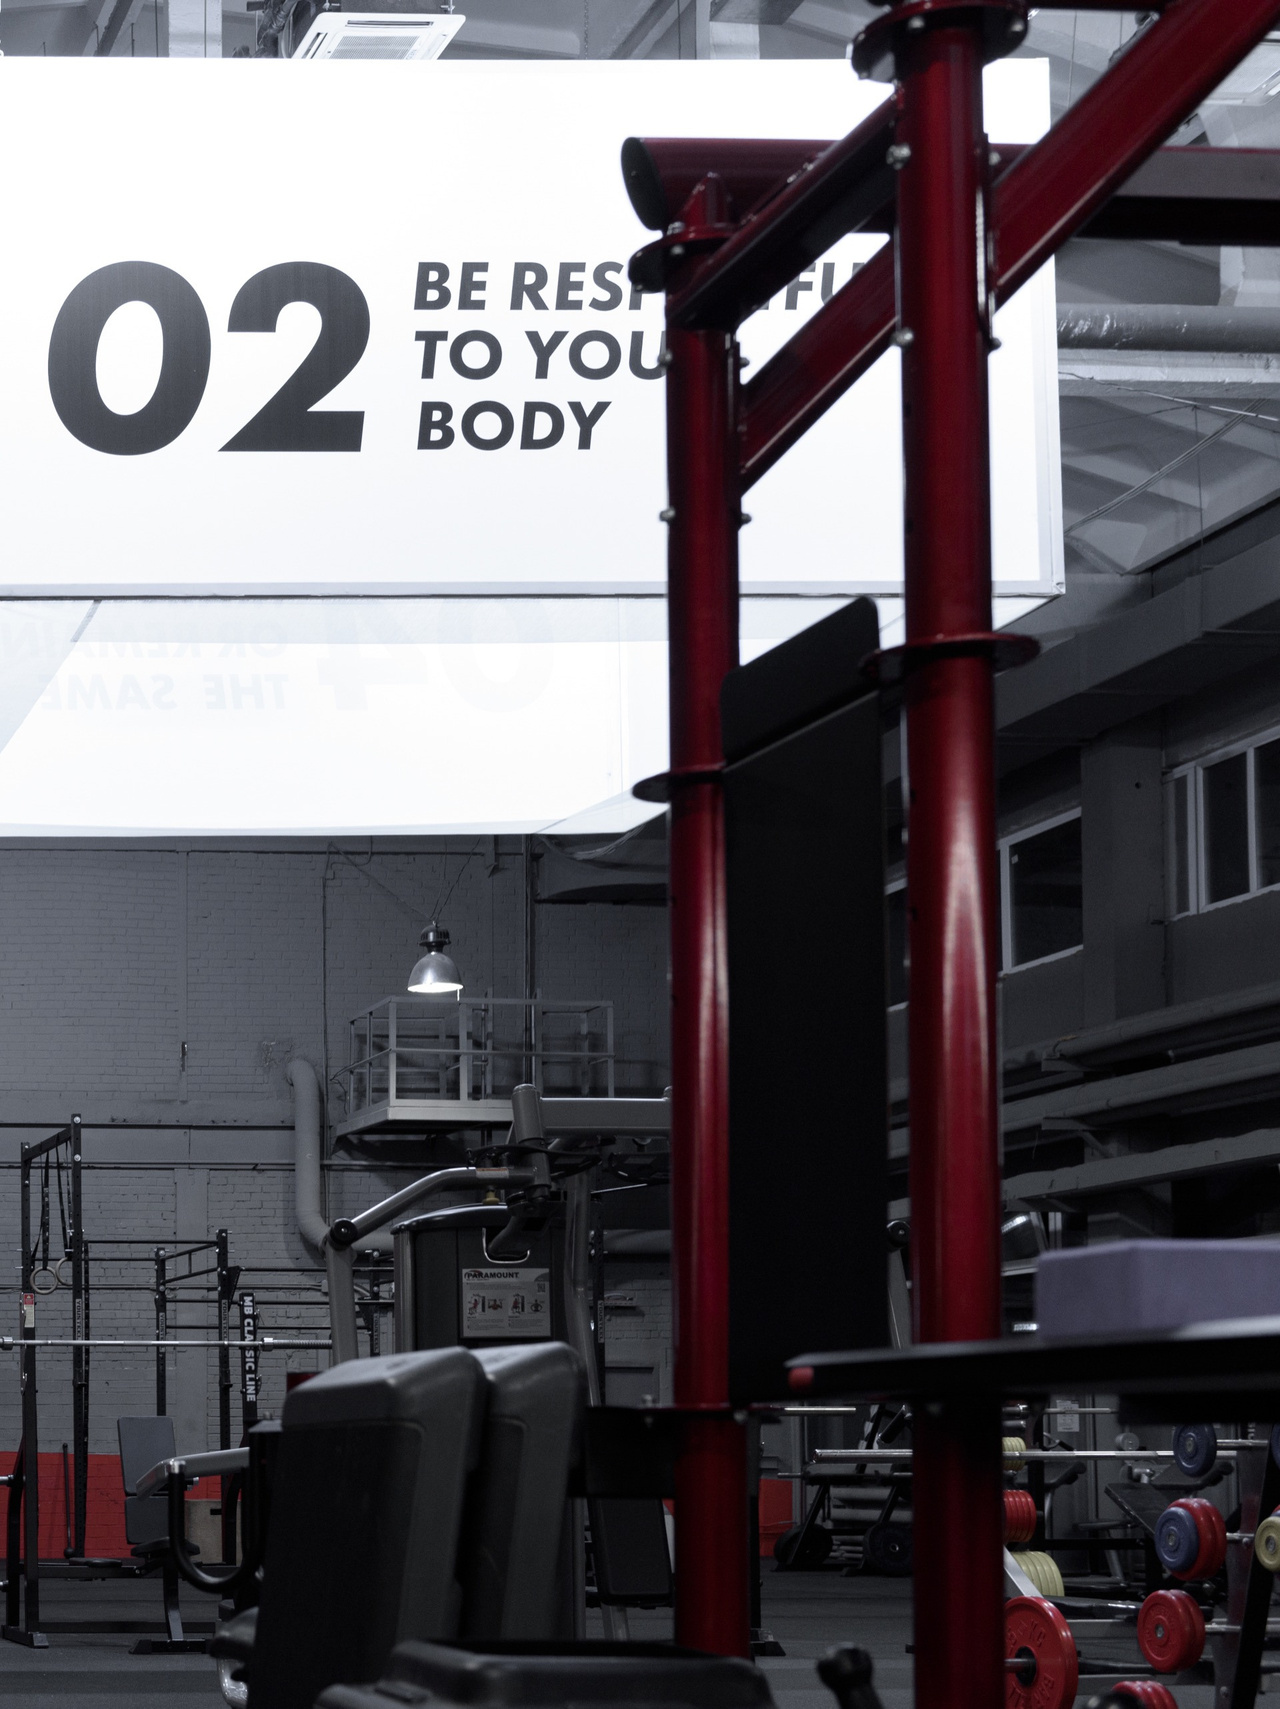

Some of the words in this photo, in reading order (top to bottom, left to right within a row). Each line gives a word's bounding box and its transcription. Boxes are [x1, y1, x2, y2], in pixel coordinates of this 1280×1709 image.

[414, 262, 489, 311] BE
[48, 261, 371, 455] 02
[415, 330, 503, 381] TO
[525, 330, 668, 381] YOU
[416, 401, 612, 451] BODY
[466, 1271, 520, 1279] PARAMOUNT
[243, 1295, 254, 1316] MB
[243, 1318, 255, 1371] CLASIC
[245, 1373, 257, 1402] LINE
